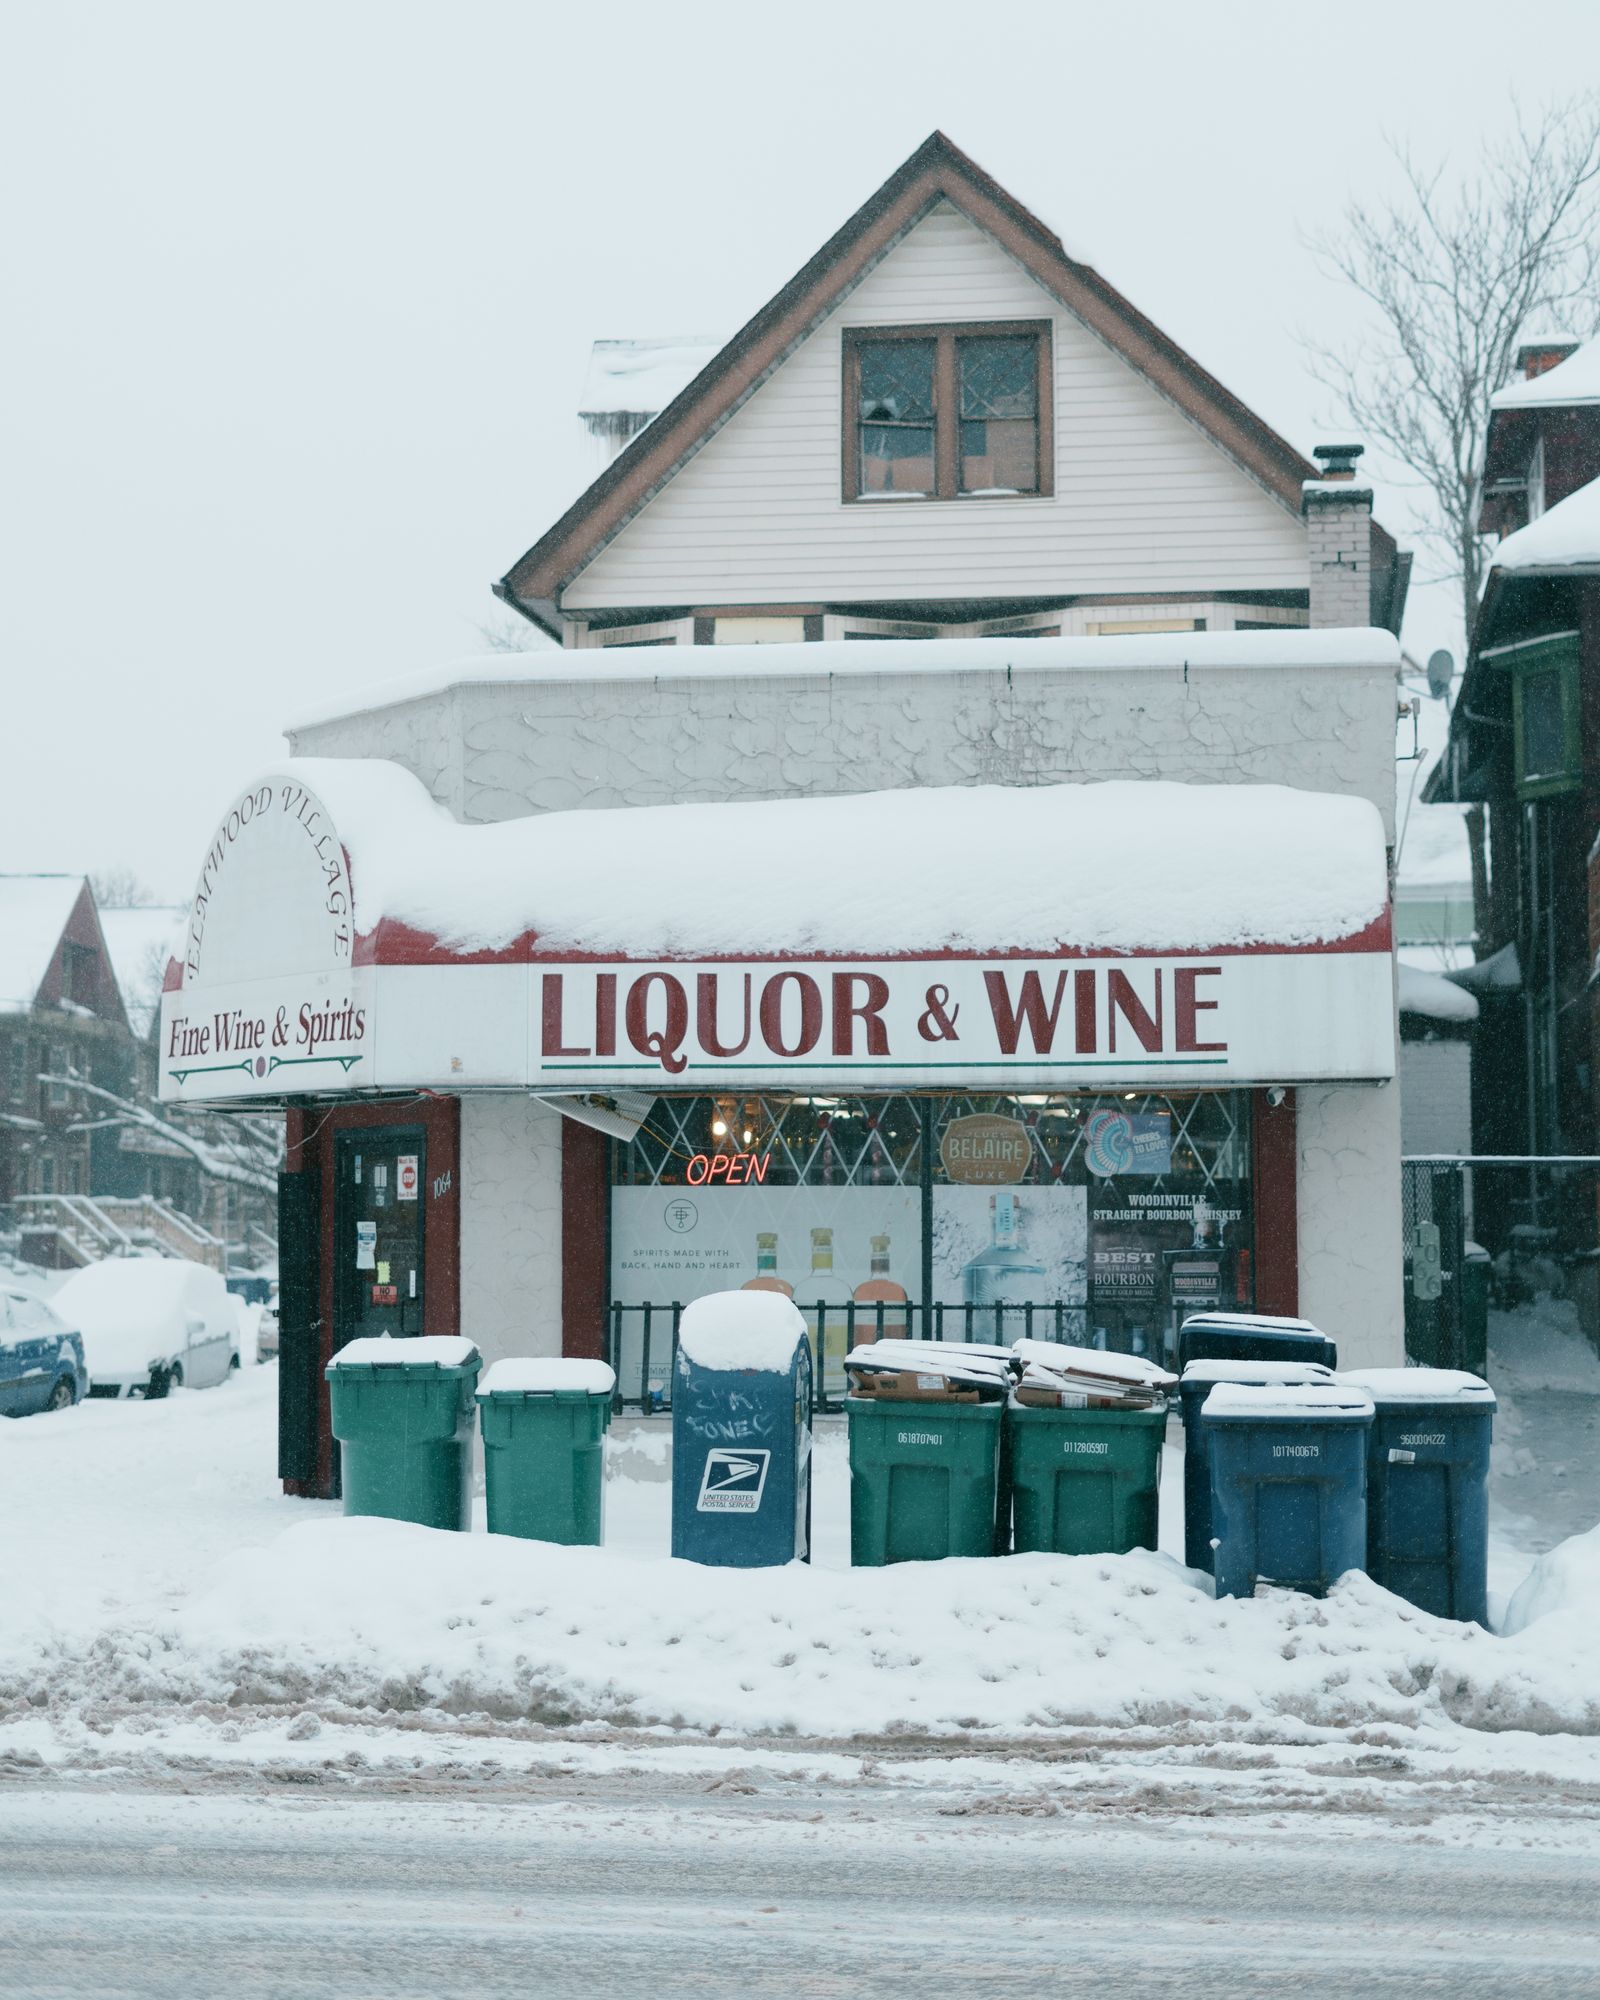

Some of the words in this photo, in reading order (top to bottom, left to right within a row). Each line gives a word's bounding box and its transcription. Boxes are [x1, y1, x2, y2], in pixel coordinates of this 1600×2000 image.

[189, 786, 271, 980] ELMWOOD
[282, 786, 348, 957] VILLAGE
[541, 971, 890, 1074] LIQUOR
[917, 983, 960, 1041] &
[984, 966, 1228, 1055] WINE
[168, 1018, 210, 1058] Fine
[214, 1010, 265, 1053] Wine
[271, 1005, 289, 1047] &
[296, 997, 366, 1055] Spirits
[1132, 1131, 1161, 1144] CHEERS
[949, 1137, 1024, 1163] BELAIRE
[1134, 1145, 1144, 1154] TO
[686, 1152, 770, 1185] OPEN
[964, 1170, 1007, 1180] LUXE
[404, 1172, 415, 1183] STOP
[433, 1169, 451, 1200] 1064
[1128, 1194, 1207, 1207] WOODINVILLE
[1093, 1209, 1144, 1221] STRAIGHT
[1146, 1209, 1192, 1221] BOURBON
[1093, 1252, 1155, 1263] BEST
[621, 1262, 650, 1270] BACK,
[1094, 1273, 1154, 1286] BOURBON
[379, 1287, 390, 1295] NO
[898, 1431, 943, 1446] 0618707401
[1064, 1441, 1109, 1455] 0112805907
[1272, 1445, 1319, 1458] 1017400679
[728, 1501, 756, 1509] SERVICE
